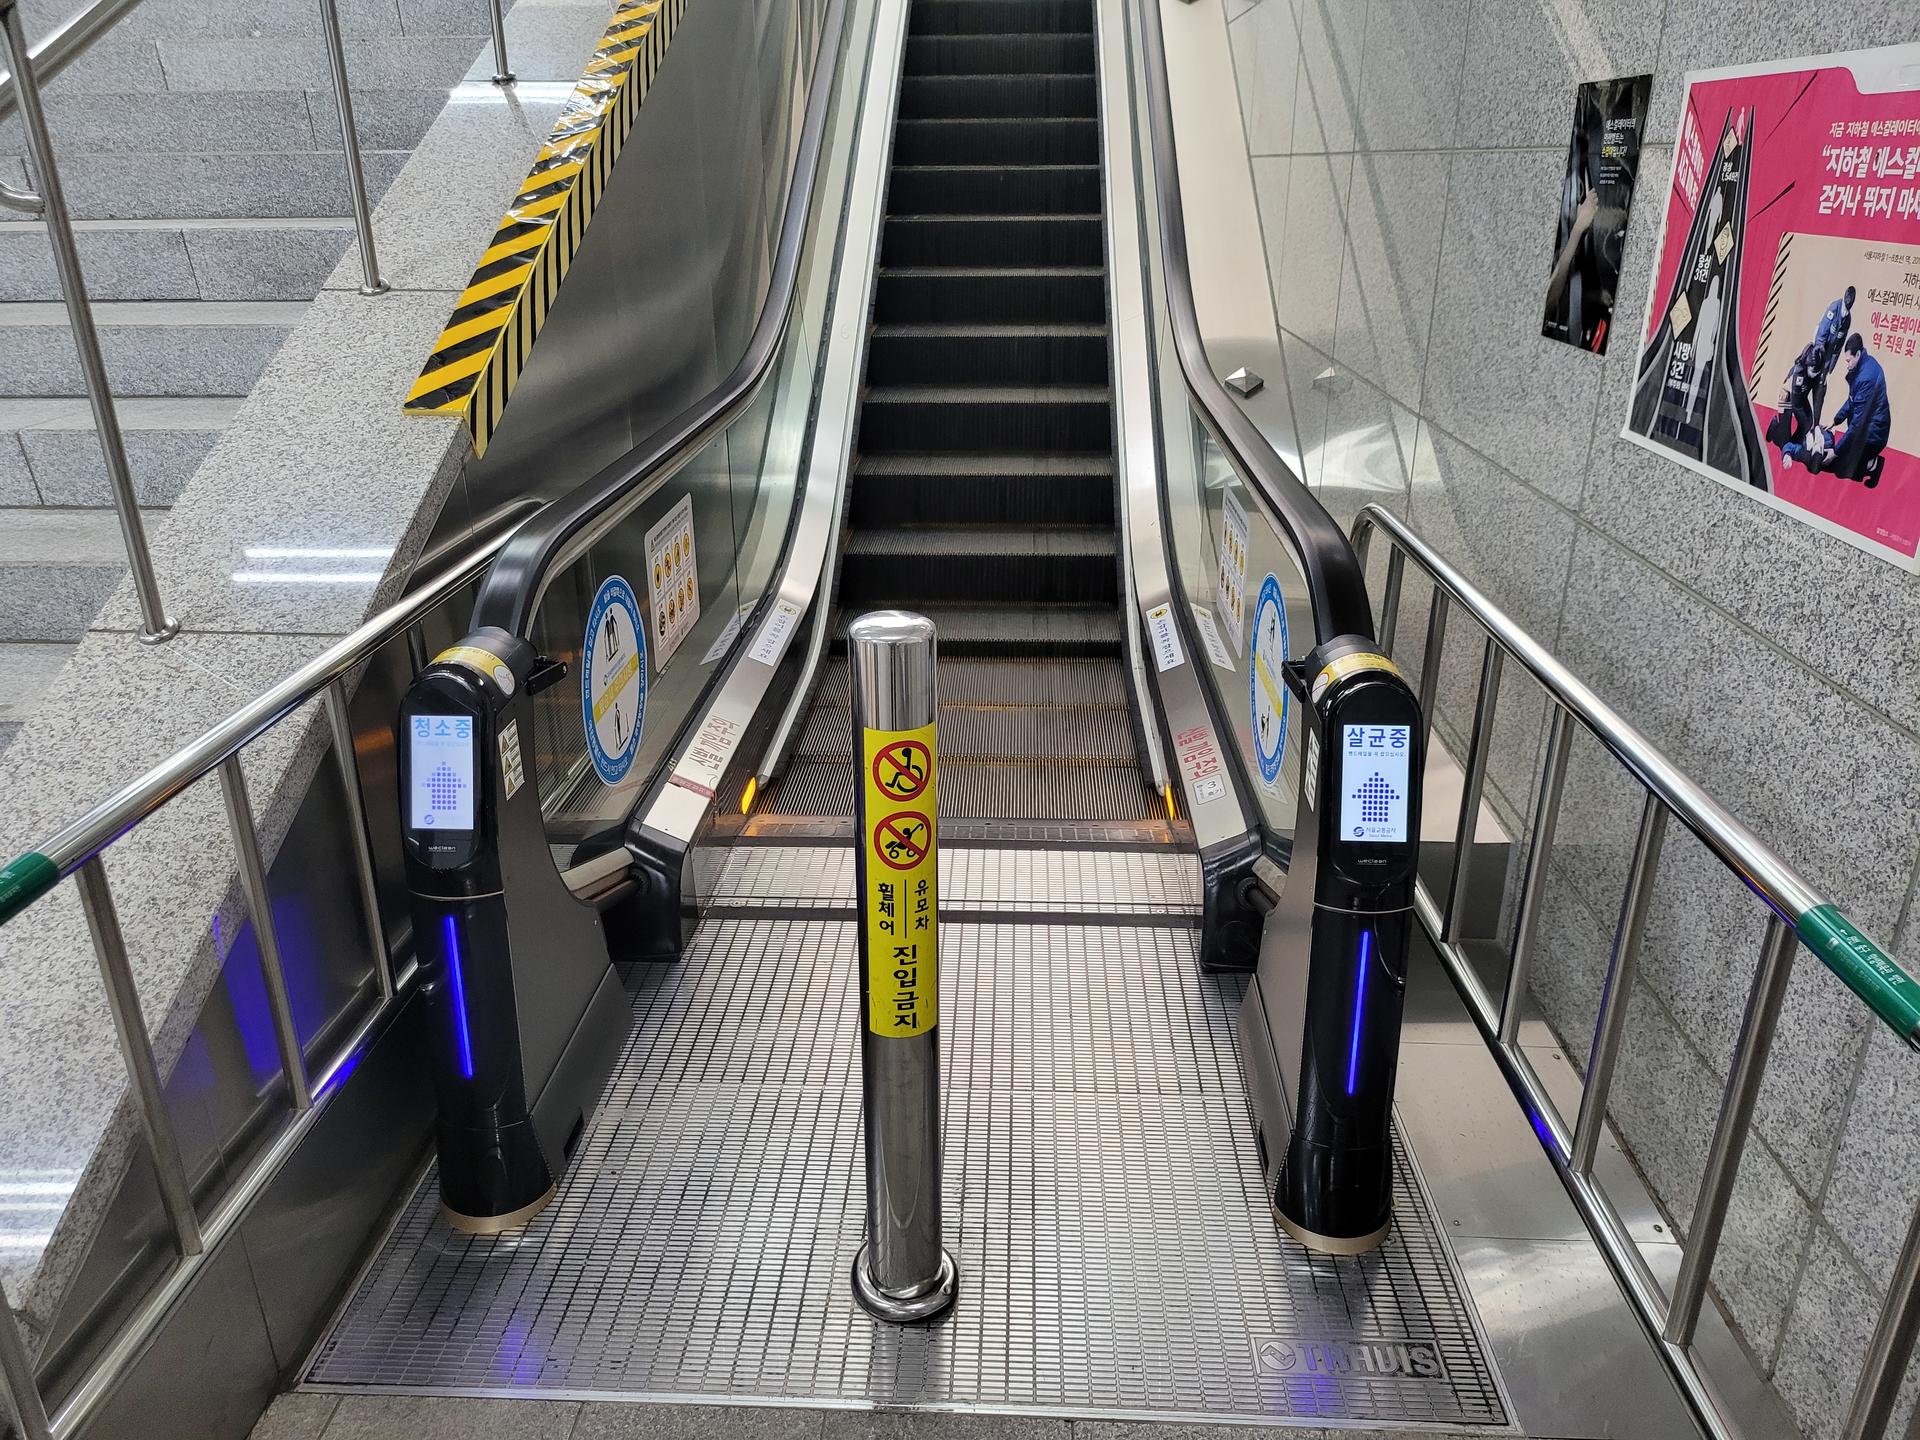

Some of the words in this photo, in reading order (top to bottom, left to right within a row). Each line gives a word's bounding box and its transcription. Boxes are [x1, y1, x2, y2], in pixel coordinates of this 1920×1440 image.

[1829, 121, 1844, 138] 지금
[1846, 120, 1870, 137] 지하철
[1873, 145, 1920, 180] 에스컬
[1818, 184, 1862, 217] 걷거나
[1863, 186, 1897, 219] 뛰지
[1697, 254, 1712, 269] 중상
[1694, 268, 1709, 283] 31건
[1903, 272, 1920, 290] 지하
[1867, 288, 1914, 309] 에스컬레이터
[1673, 341, 1691, 361] 사망
[1873, 332, 1883, 350] 역
[1885, 334, 1905, 354] 직원
[1905, 340, 1917, 358] 및
[1670, 360, 1685, 380] 3건
[415, 718, 472, 739] 청소중
[1347, 727, 1408, 748] 살균중
[688, 745, 723, 772] 신발
[706, 712, 740, 739] 주의
[1183, 756, 1222, 781] 주의
[877, 882, 895, 937] 휠체어
[914, 878, 930, 931] 유모차
[892, 945, 918, 1030] 진입금지
